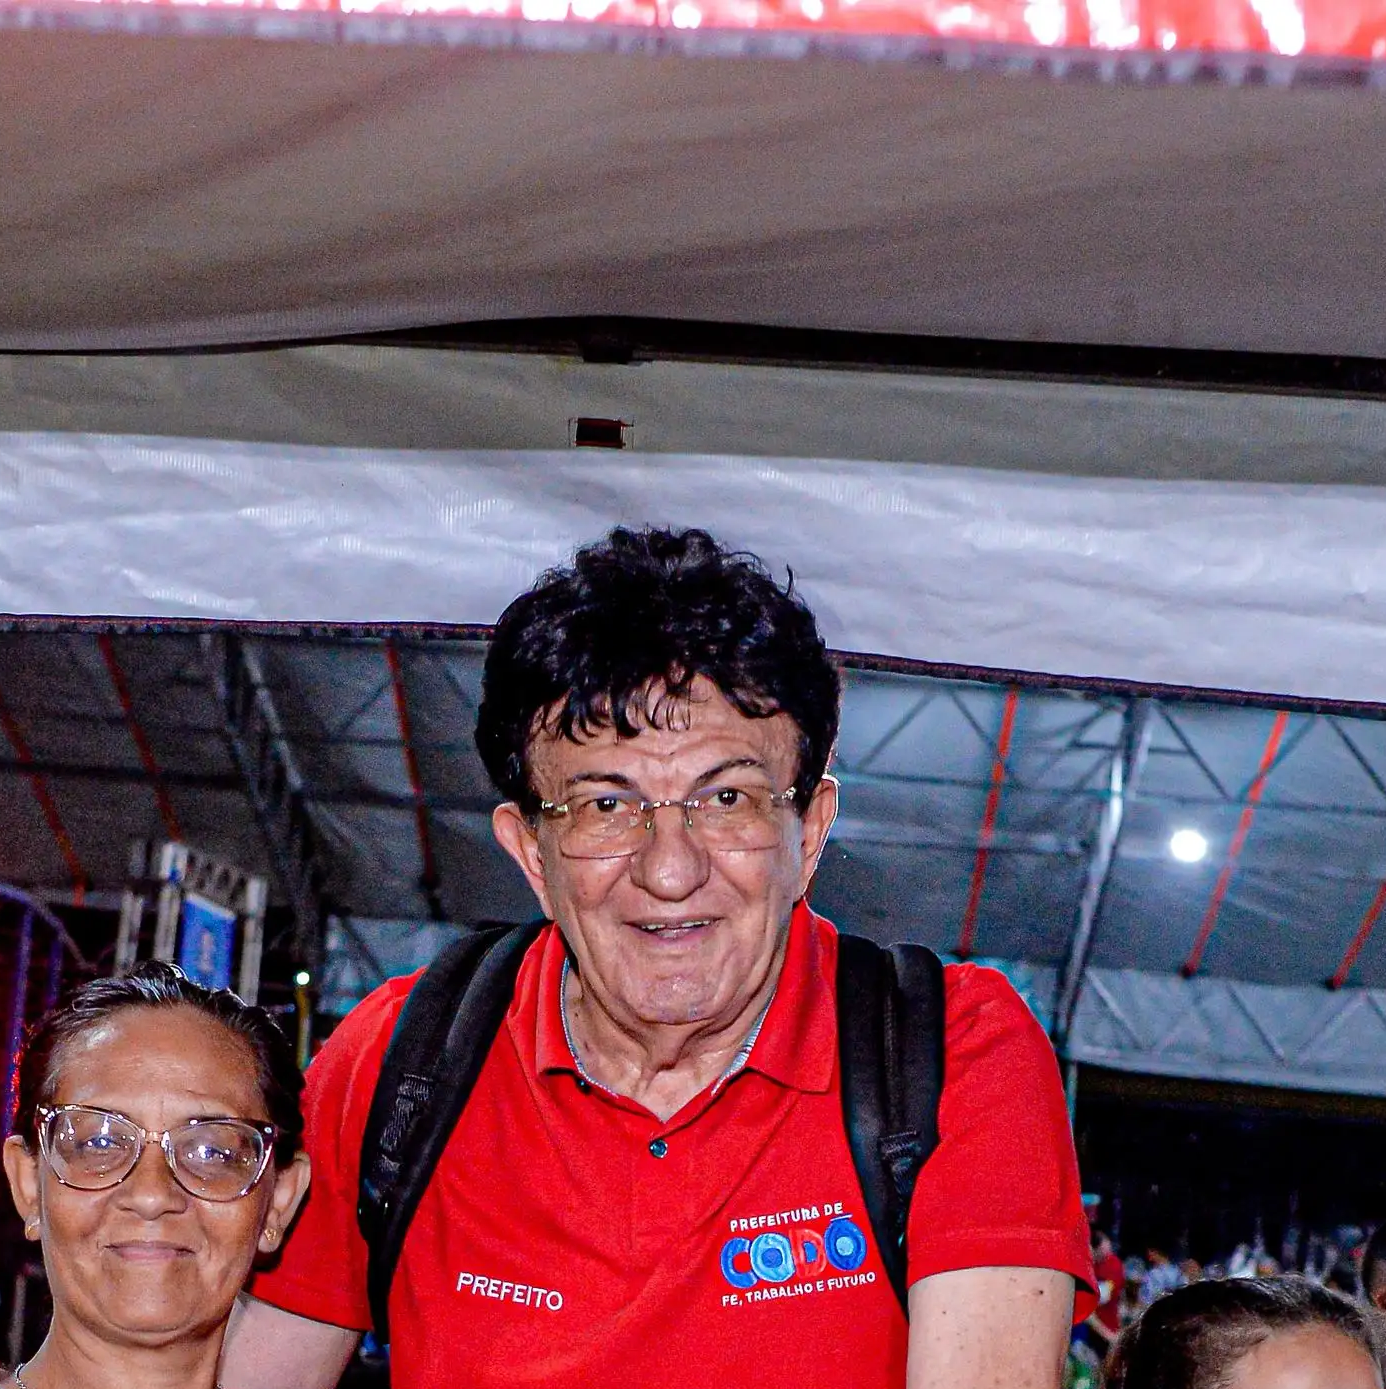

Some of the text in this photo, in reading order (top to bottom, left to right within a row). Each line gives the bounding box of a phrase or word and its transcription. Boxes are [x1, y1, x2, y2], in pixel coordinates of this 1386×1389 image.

[729, 1202, 844, 1233] PREFEITURA DE
[456, 1272, 564, 1311] PREFEITO
[745, 1282, 814, 1304] TRABALHO
[816, 1279, 825, 1292] E
[827, 1271, 876, 1291] FUTURO
